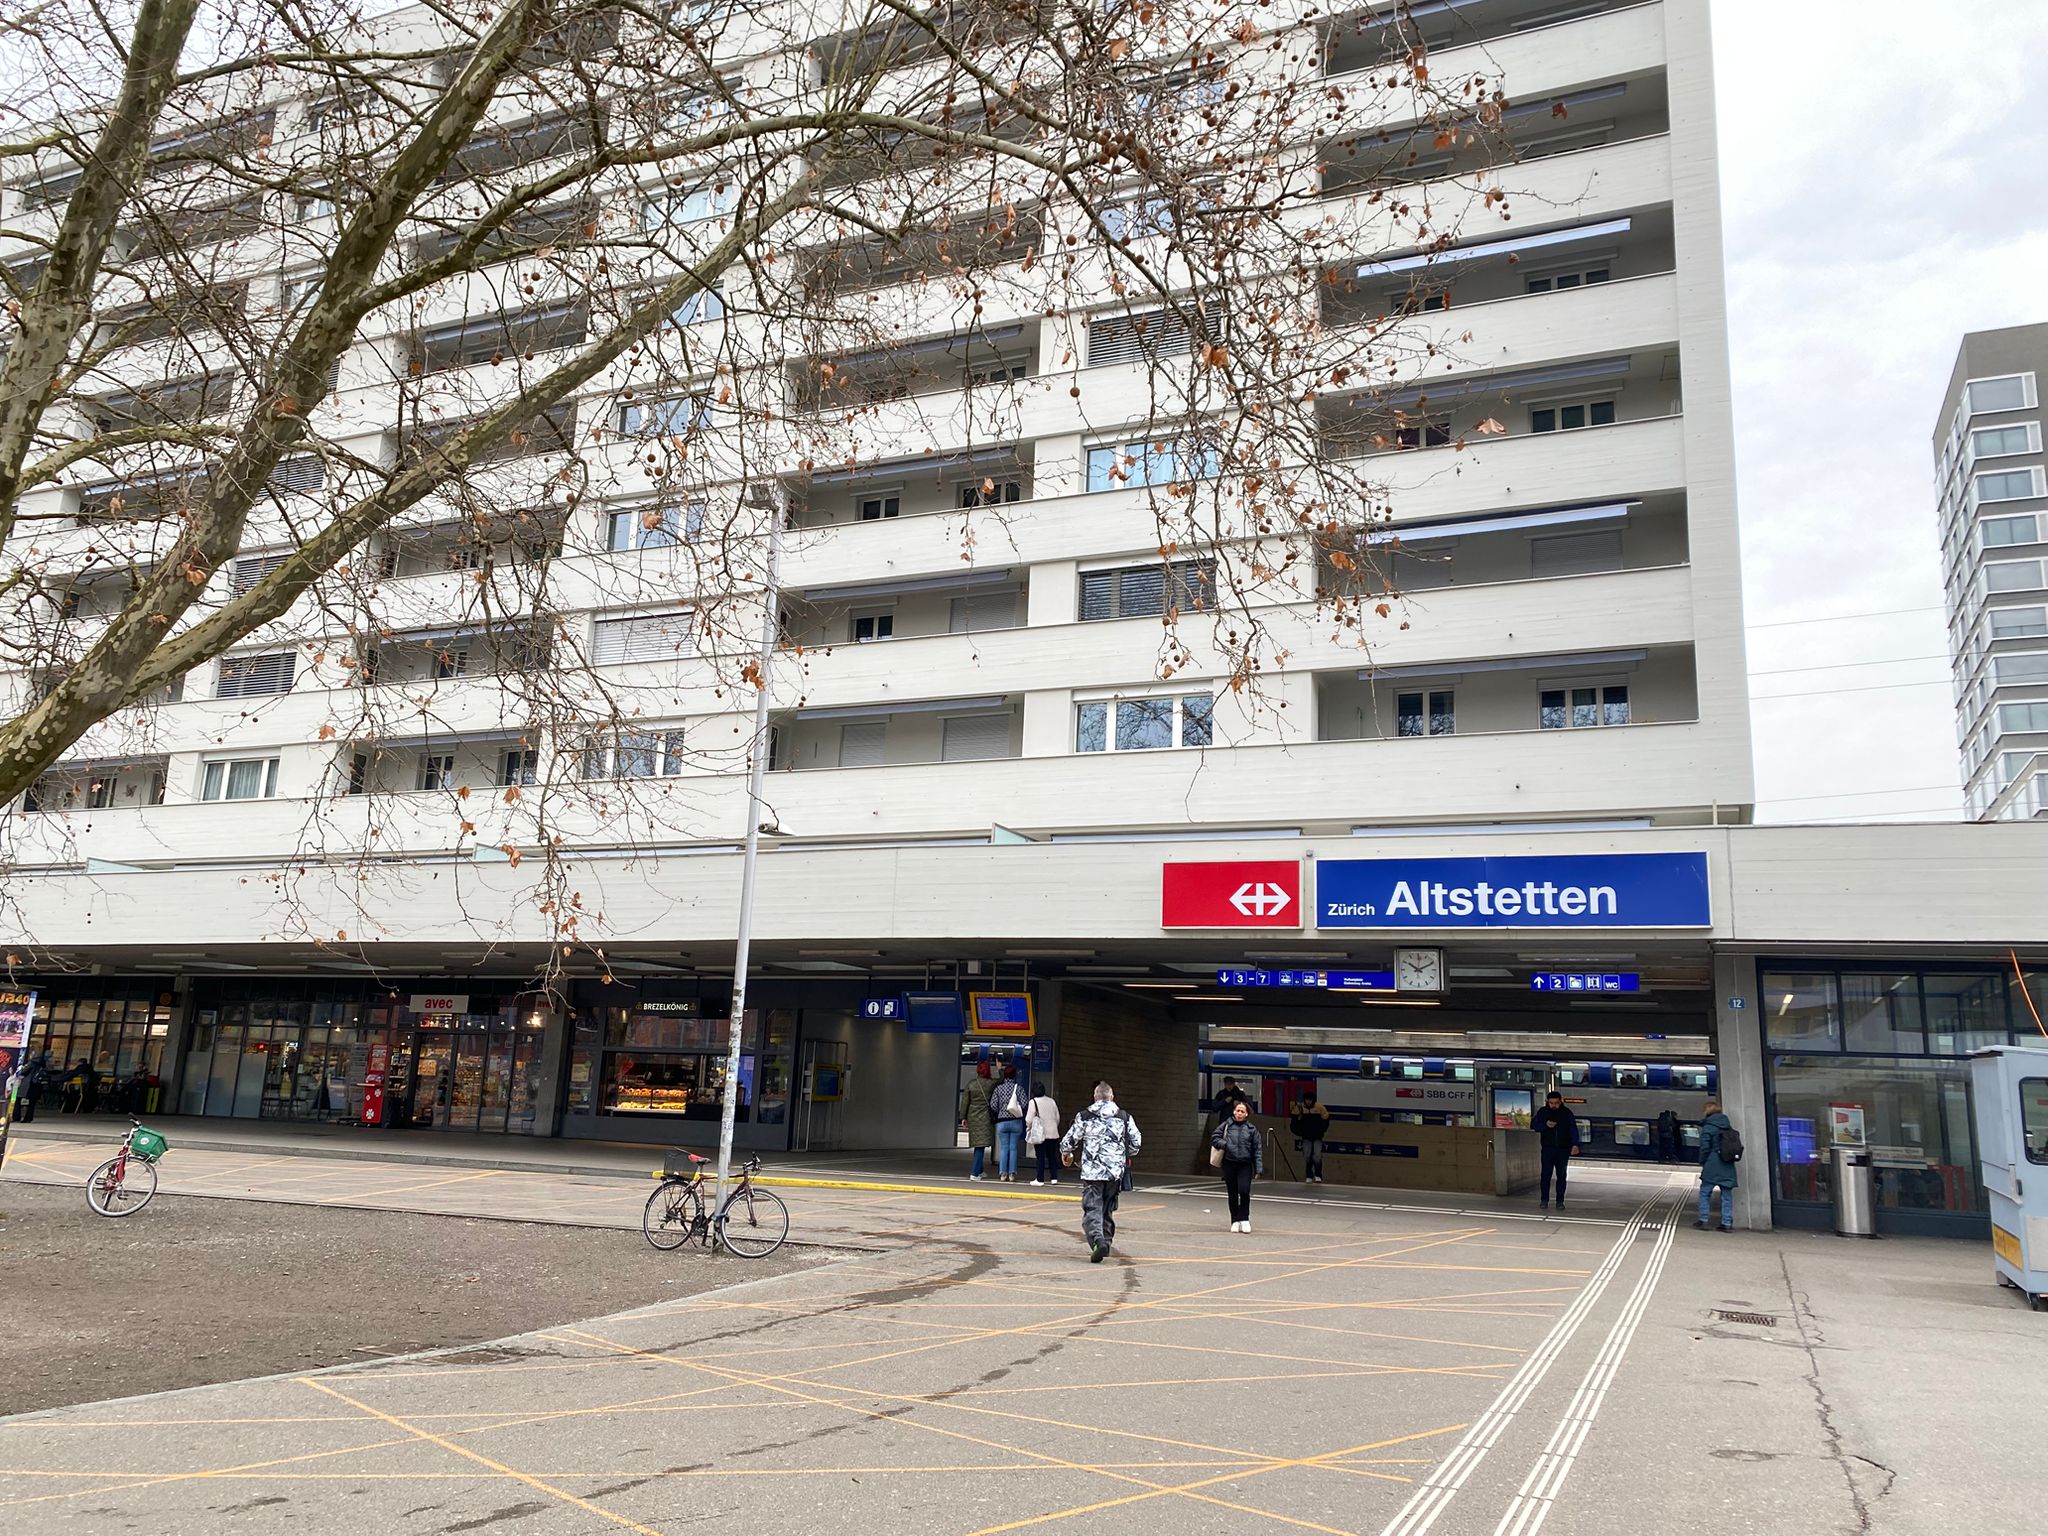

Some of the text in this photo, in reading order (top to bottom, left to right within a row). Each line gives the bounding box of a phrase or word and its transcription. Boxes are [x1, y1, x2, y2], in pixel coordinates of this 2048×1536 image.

[1327, 880, 1618, 916] Zürich Altstetten
[1237, 974, 1244, 984] 3
[1260, 974, 1266, 984] 7
[1554, 979, 1562, 988] 2
[424, 998, 453, 1009] avec
[643, 1002, 689, 1011] BREZELKÖNIG
[1732, 999, 1743, 1008] 12
[1426, 1090, 1446, 1099] SBB
[1447, 1091, 1466, 1099] CFF
